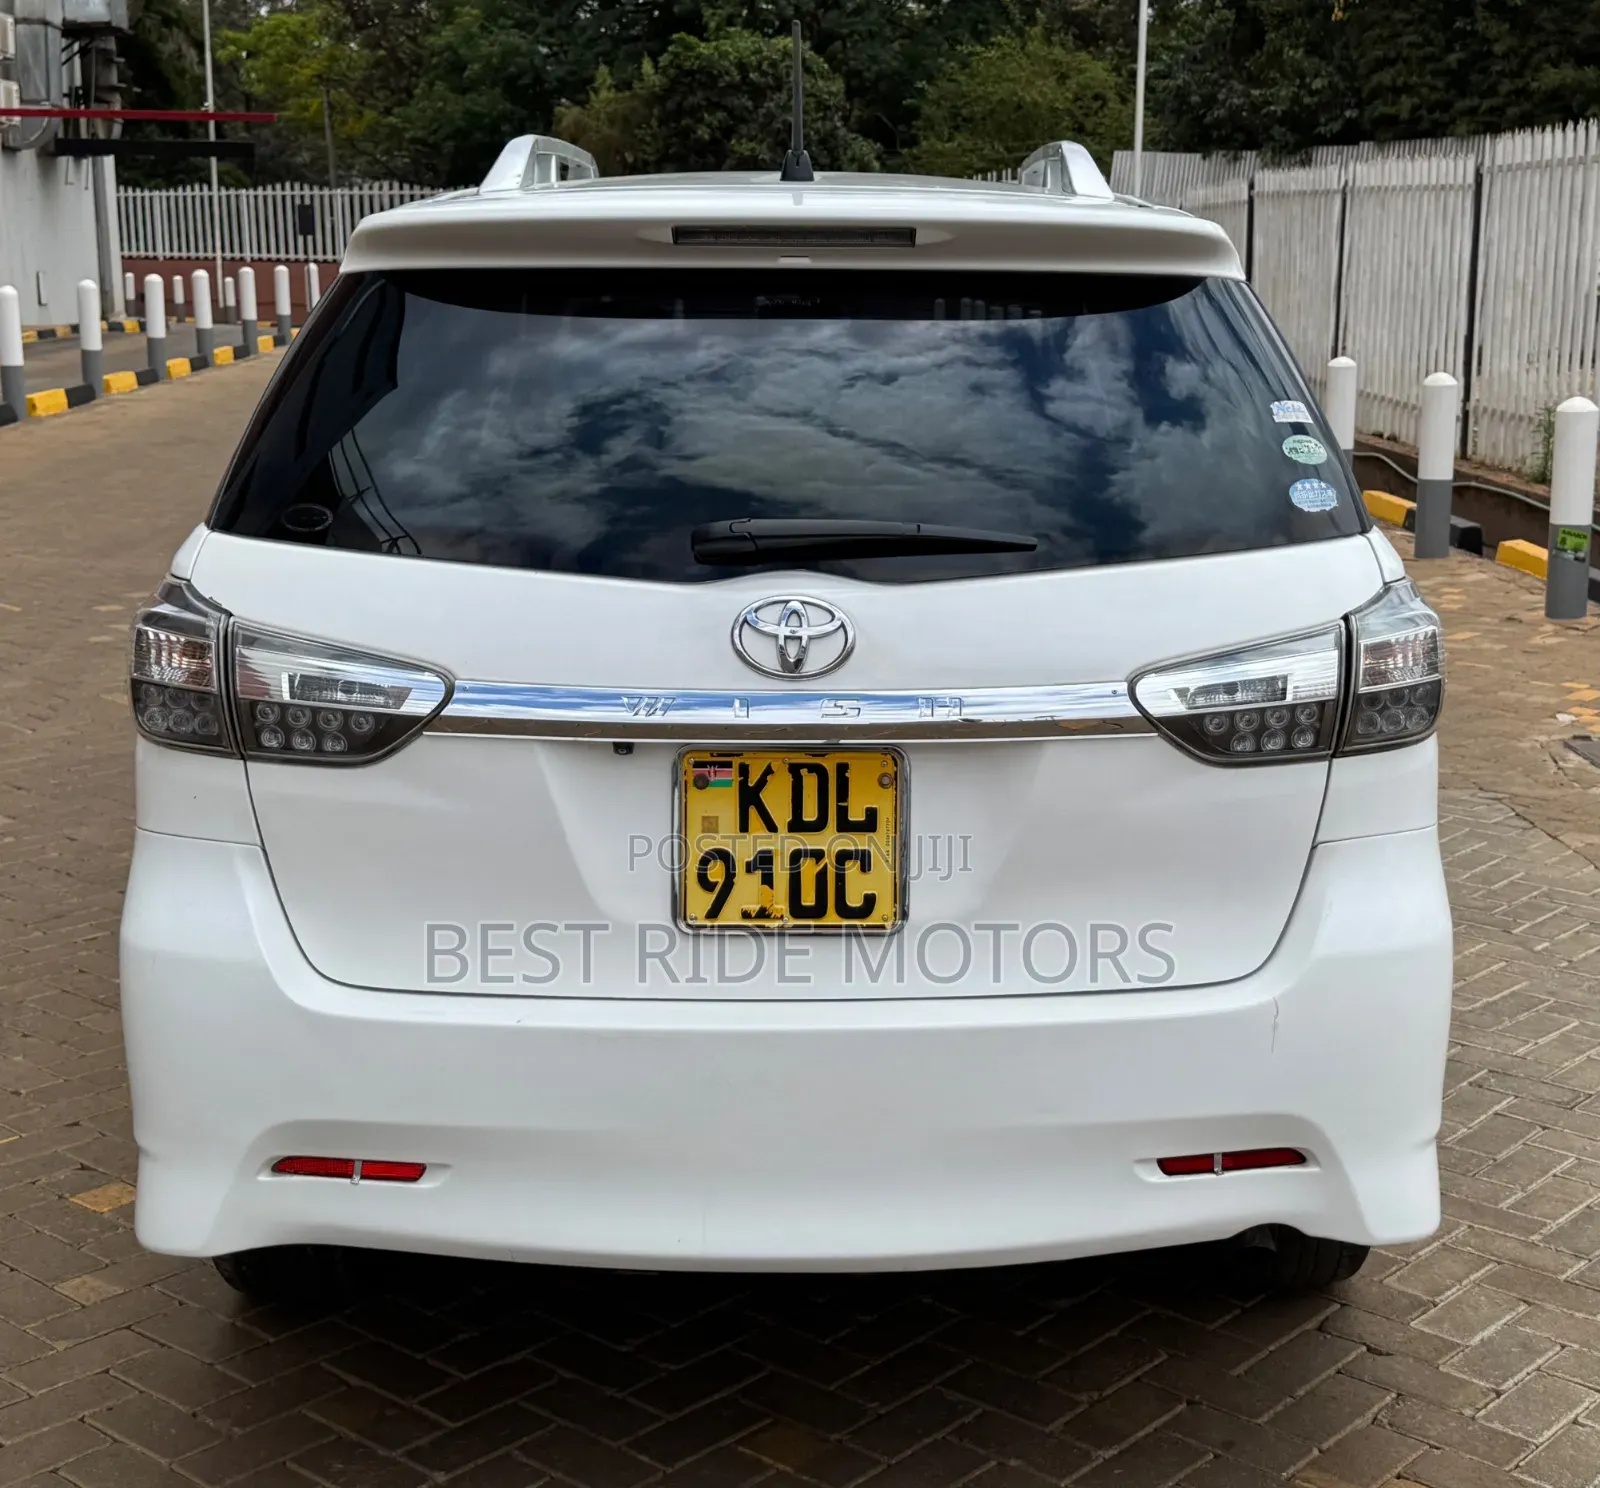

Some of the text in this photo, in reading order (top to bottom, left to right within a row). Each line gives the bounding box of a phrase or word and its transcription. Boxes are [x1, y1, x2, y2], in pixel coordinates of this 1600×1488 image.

[622, 695, 965, 720] WISH
[738, 761, 879, 834] KDL
[697, 847, 878, 920] 910C
